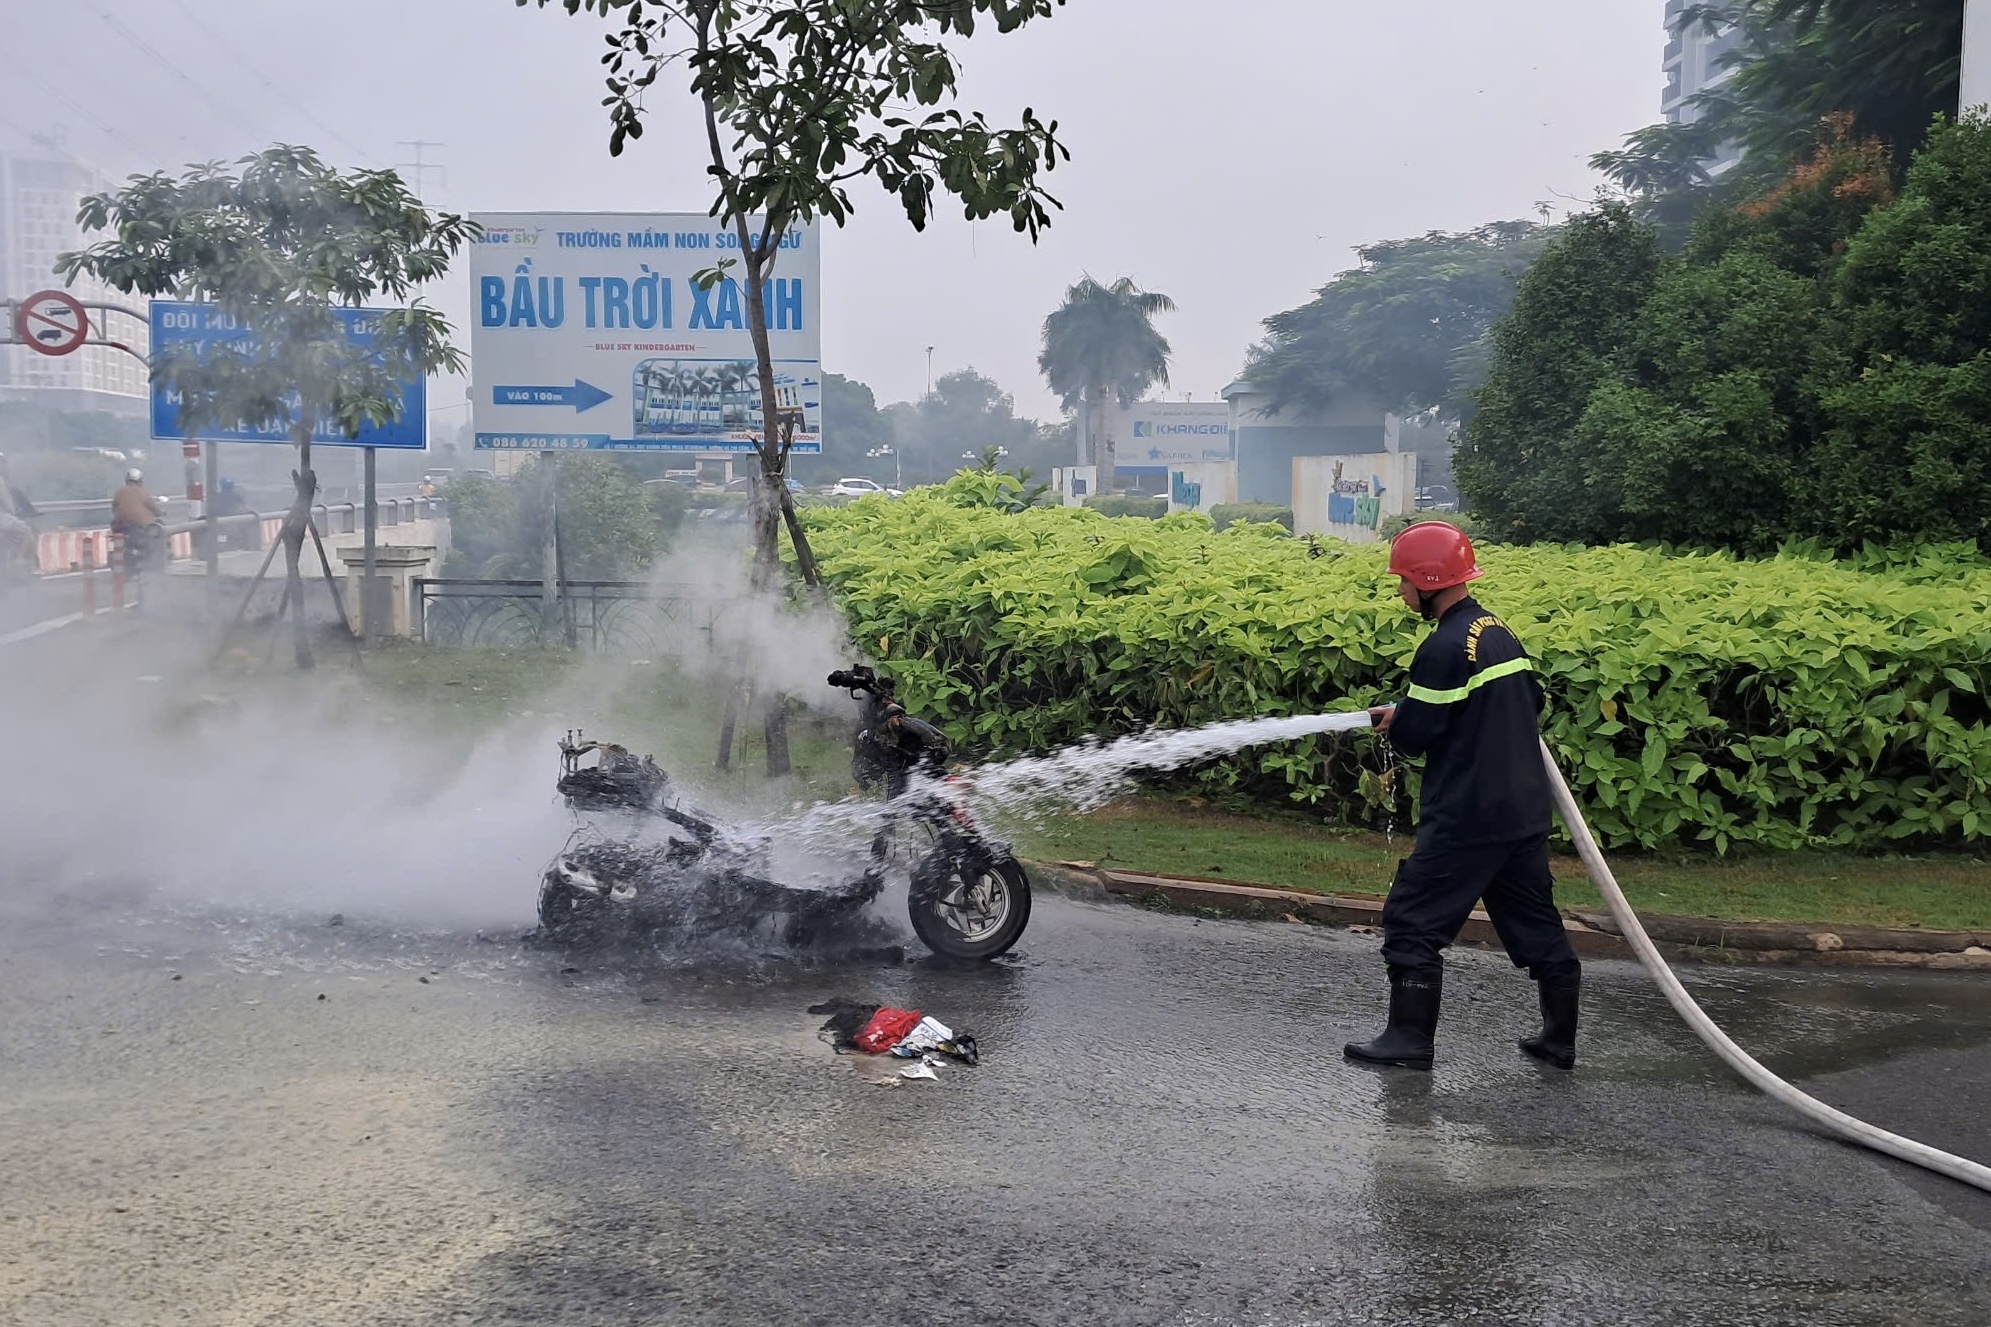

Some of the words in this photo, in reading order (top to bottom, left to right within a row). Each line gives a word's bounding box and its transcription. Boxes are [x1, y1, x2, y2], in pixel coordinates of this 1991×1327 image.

[556, 229, 621, 248] TRƯỜNG
[627, 227, 669, 248] MẦM
[674, 233, 709, 249] NON
[715, 233, 763, 249] SOG
[767, 229, 802, 249] GỮ
[480, 257, 564, 328] BẦU
[578, 264, 672, 330] TRỜI
[533, 392, 563, 401] 100m
[492, 438, 517, 448] 086
[521, 438, 547, 448] 620
[551, 438, 568, 448] 48
[572, 438, 589, 448] 59
